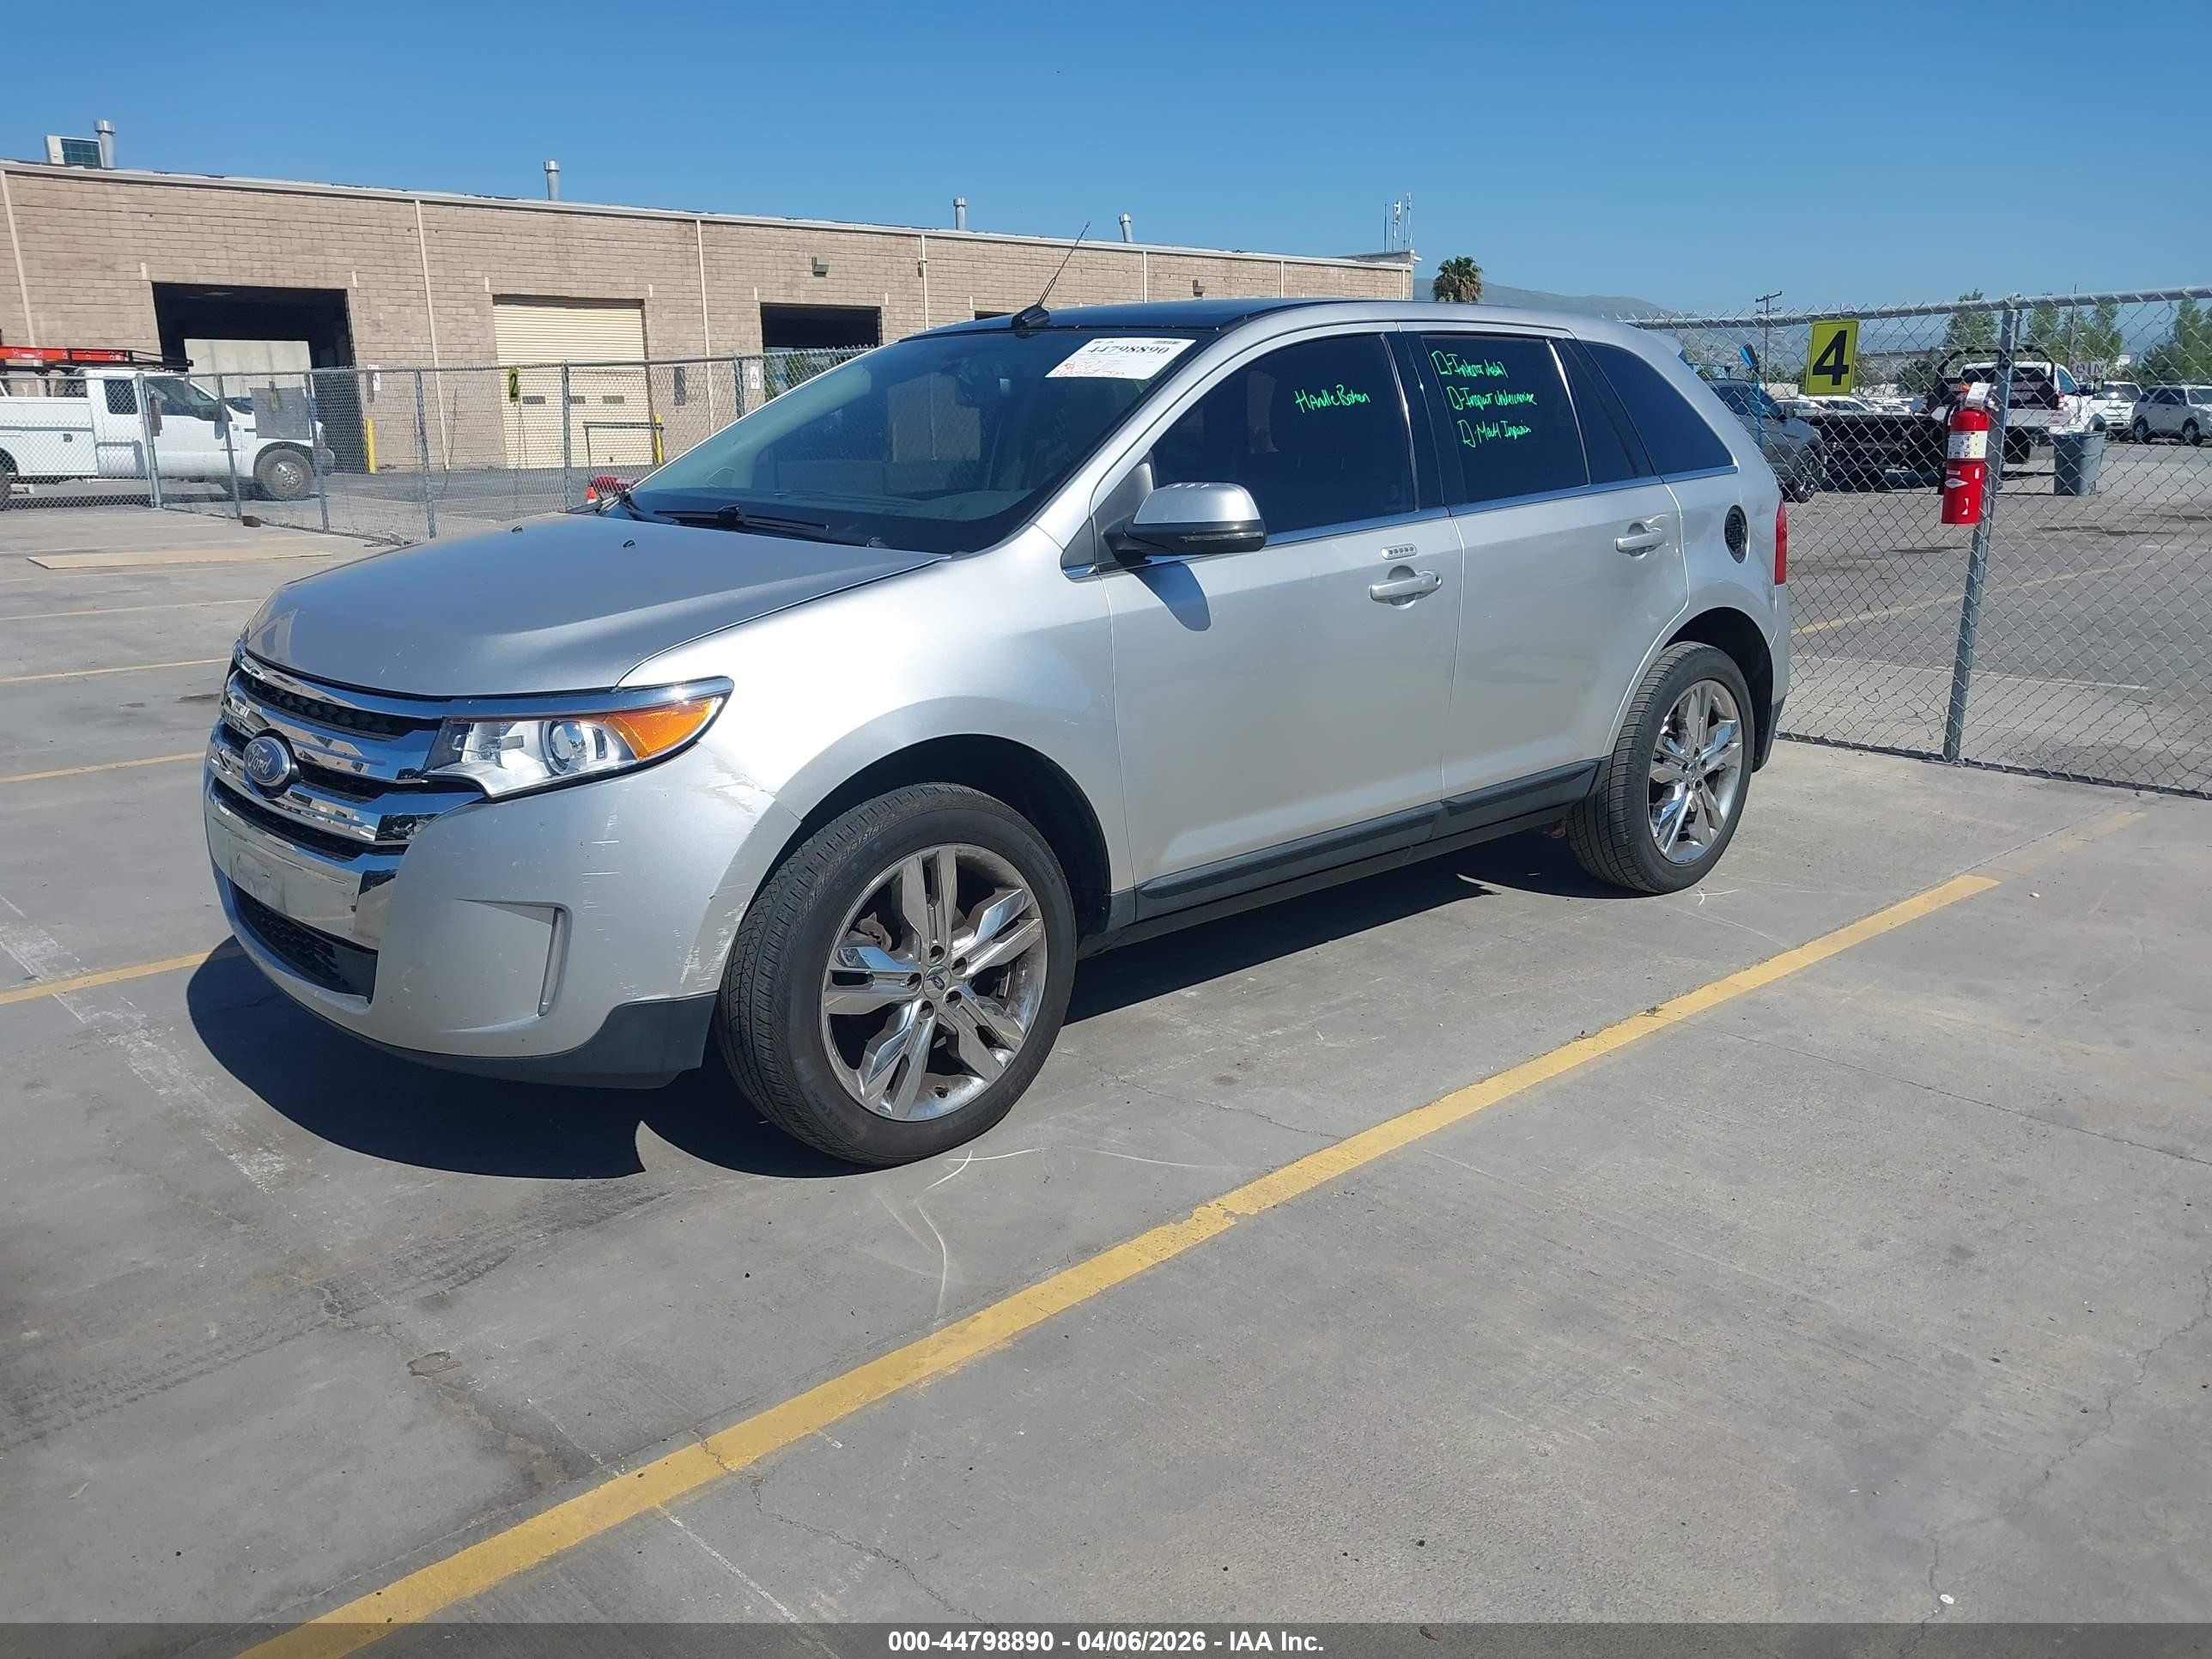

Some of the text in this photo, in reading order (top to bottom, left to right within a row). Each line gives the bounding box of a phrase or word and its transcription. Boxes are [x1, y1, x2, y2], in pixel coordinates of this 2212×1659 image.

[1813, 330, 1850, 386] 4
[510, 373, 517, 398] 2
[247, 743, 273, 775] Ford
